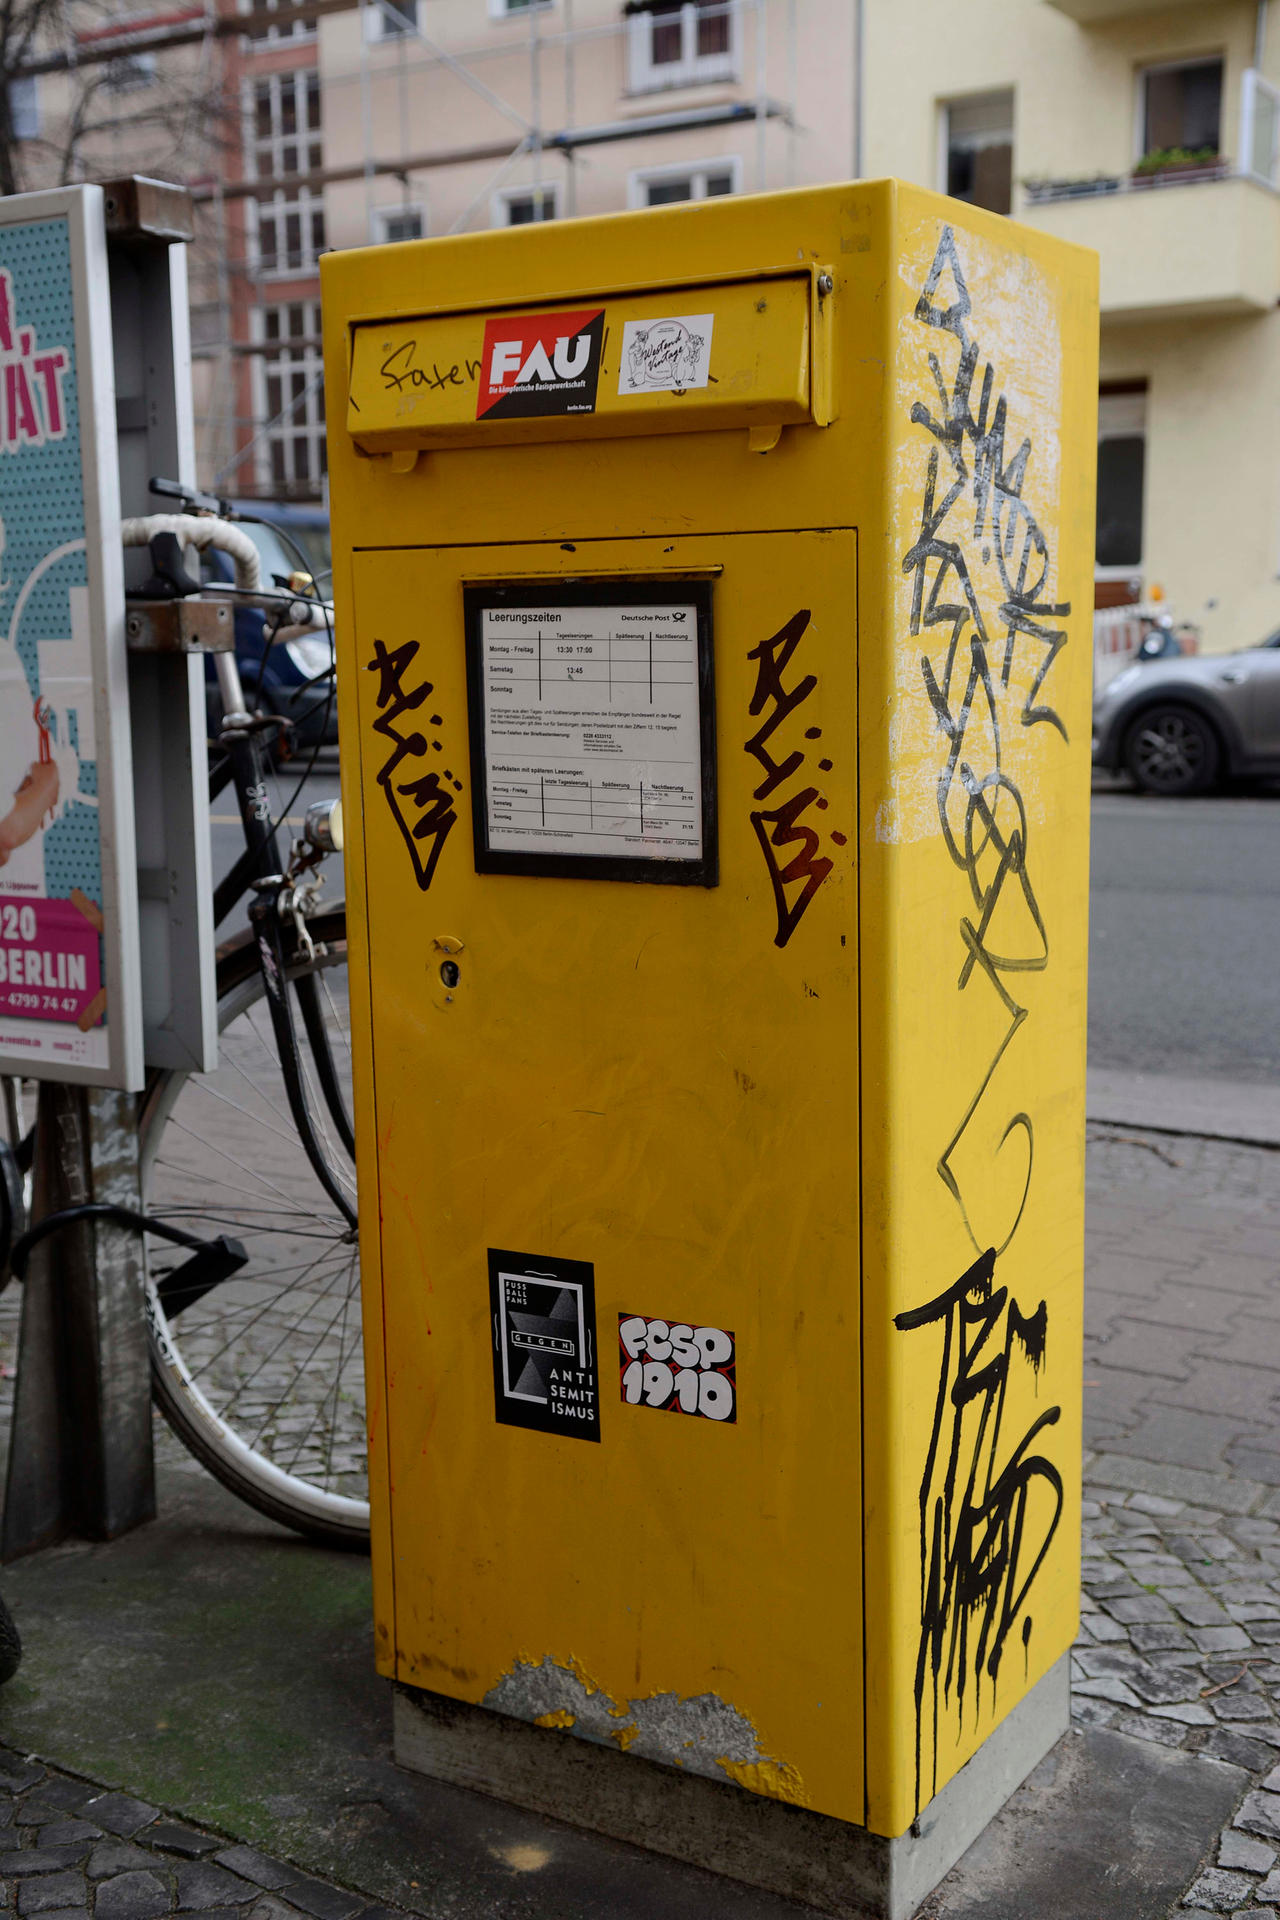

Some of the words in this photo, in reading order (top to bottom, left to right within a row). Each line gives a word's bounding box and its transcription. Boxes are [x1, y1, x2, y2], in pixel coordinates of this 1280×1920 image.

[641, 330, 682, 360] Westend
[489, 333, 591, 385] FAU
[647, 346, 683, 371] Vintage
[489, 387, 498, 395] Die
[499, 384, 535, 395] kämpferische
[535, 380, 586, 392] Basisgewerkschaft
[0, 353, 64, 441] AT
[489, 611, 562, 625] Leerungszeiten
[490, 646, 510, 654] Montag
[515, 646, 534, 654] Freitag
[490, 666, 513, 674] Samstag
[491, 686, 513, 694] Sonntag
[555, 769, 585, 777] Leerungen:
[513, 787, 528, 795] Freitag
[602, 782, 630, 790] Spätleerung
[651, 784, 684, 792] Nachtleerung
[494, 800, 512, 808] Samstag
[0, 904, 37, 941] 20
[8, 992, 40, 1009] 4799
[42, 996, 59, 1010] 74
[61, 998, 78, 1012] 47
[505, 1281, 528, 1291] FUSS
[506, 1289, 528, 1298] BALL
[506, 1296, 528, 1305] FANS
[515, 1334, 570, 1349] GEGEN
[619, 1317, 733, 1370] FCSP
[550, 1368, 594, 1387] ANTI
[551, 1385, 595, 1403] SEMIT
[623, 1360, 734, 1421] 1910
[552, 1401, 595, 1421] ISMUS
